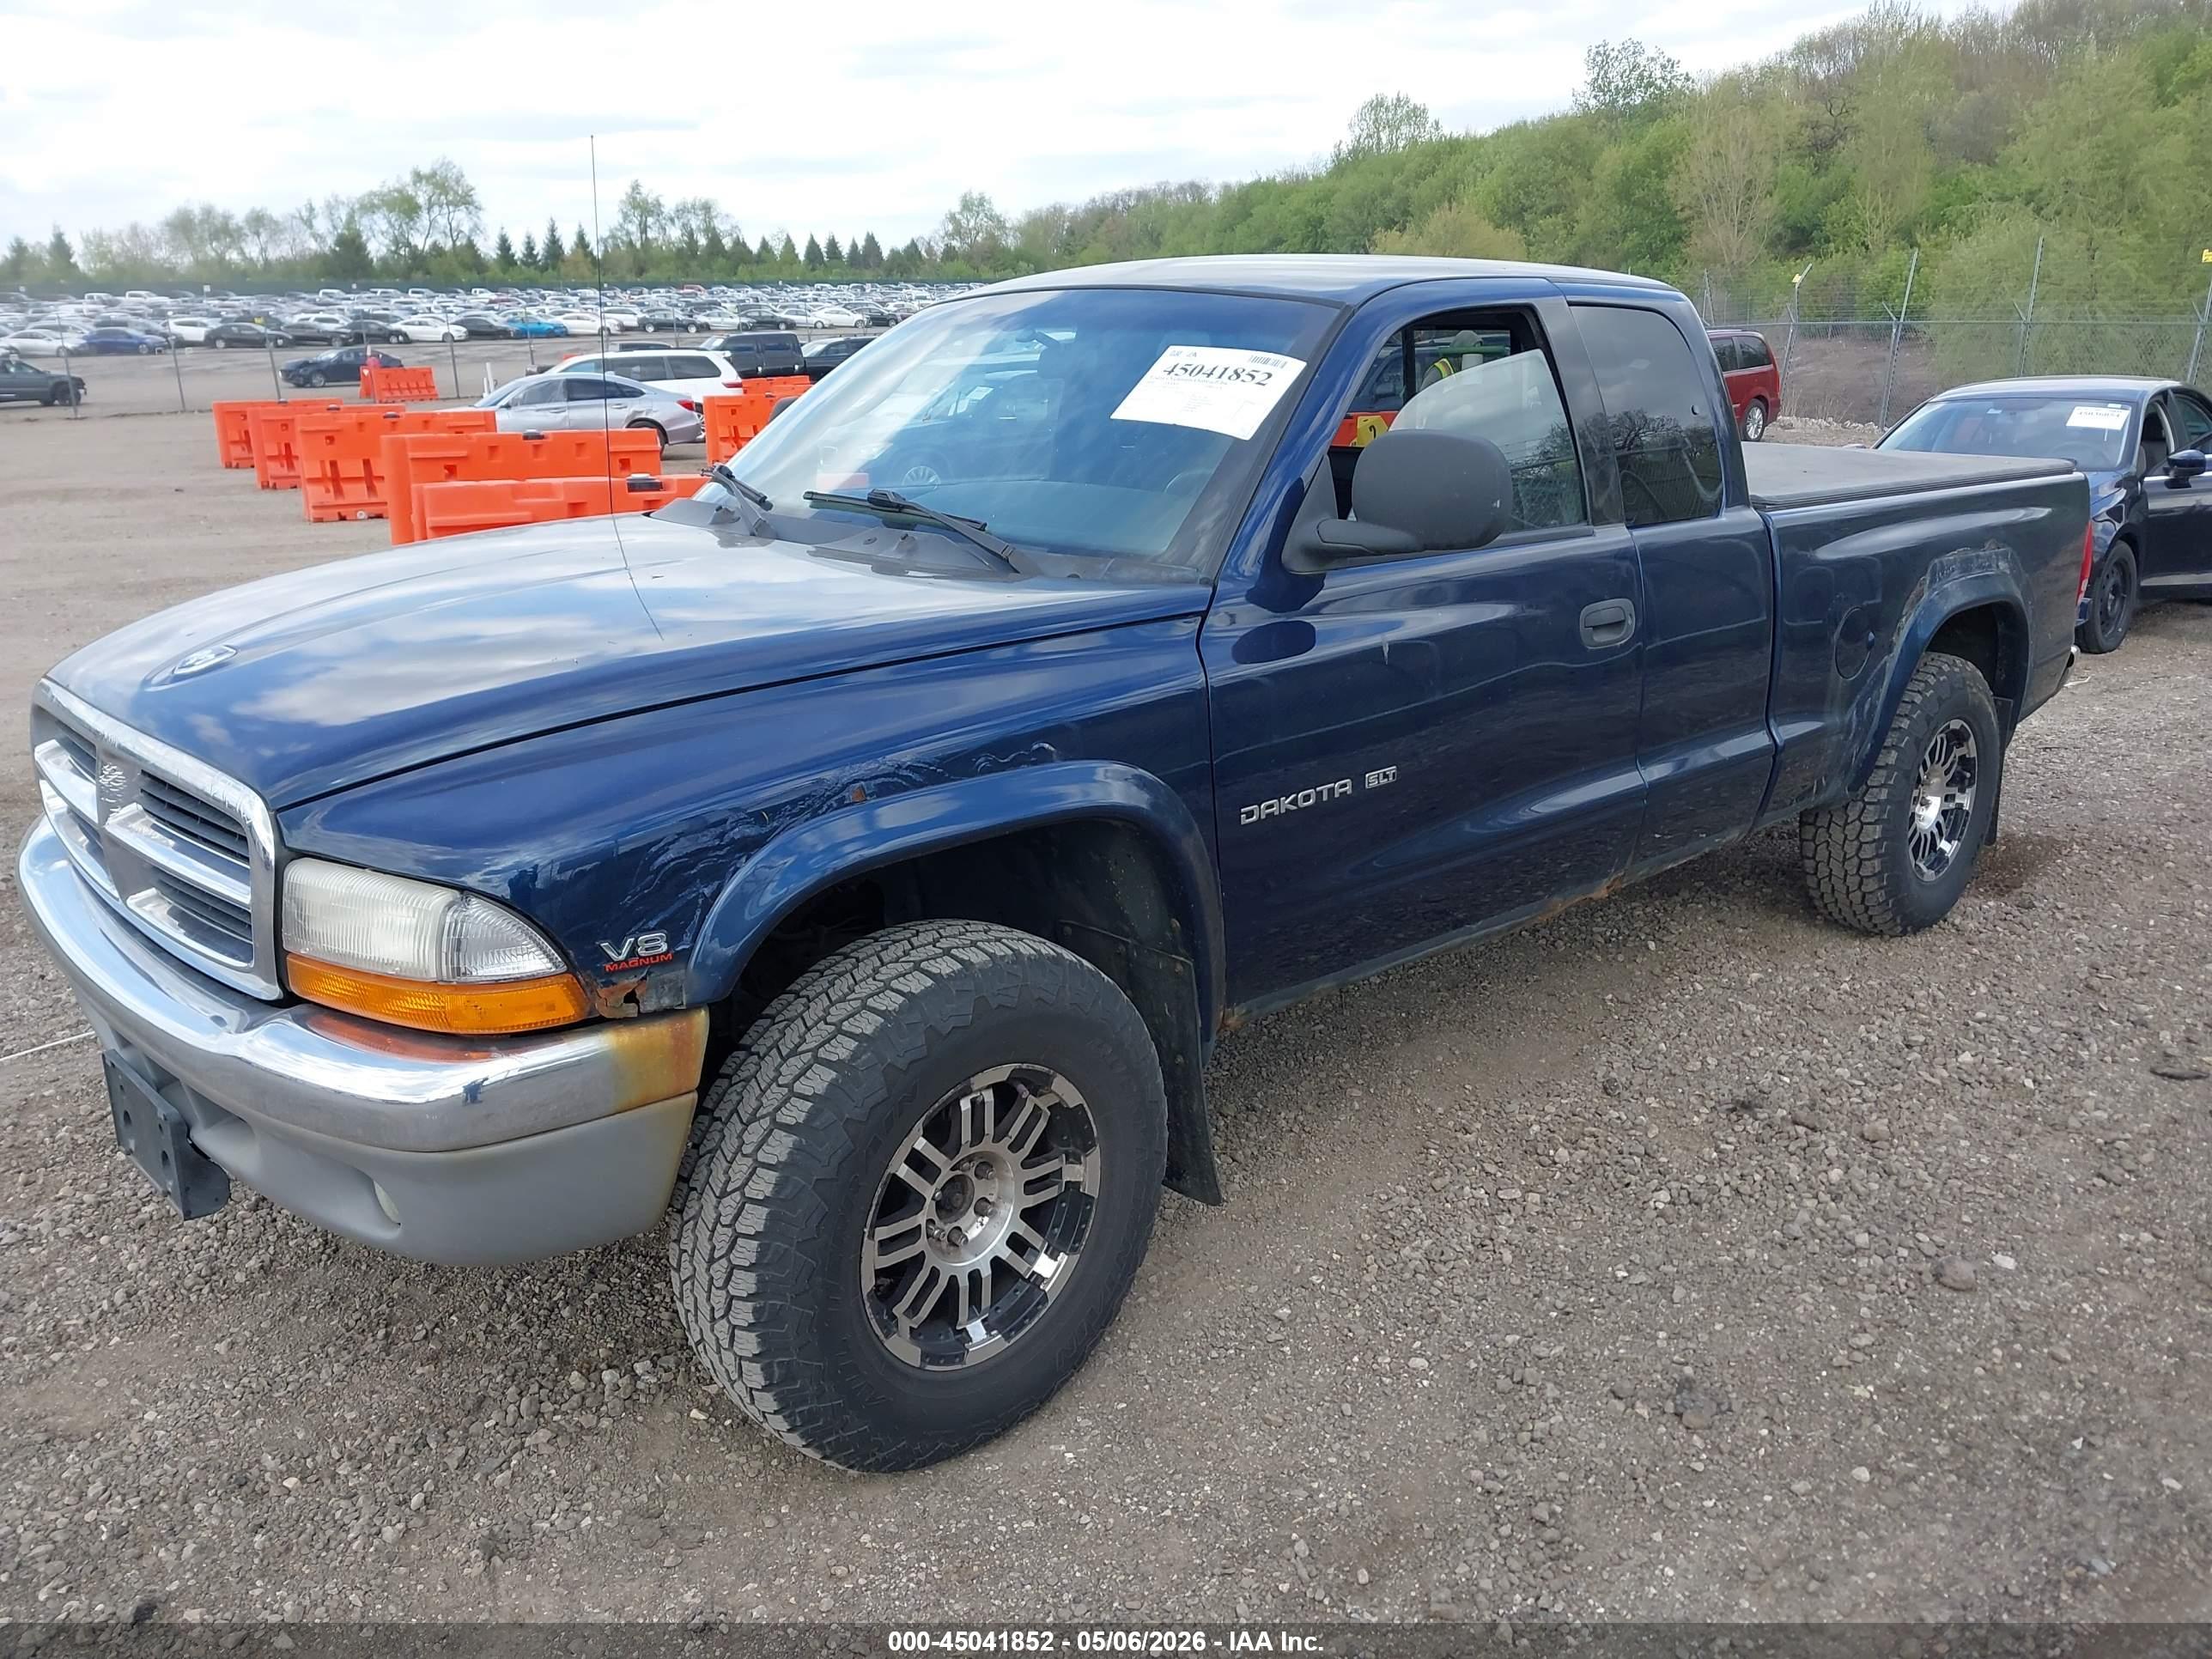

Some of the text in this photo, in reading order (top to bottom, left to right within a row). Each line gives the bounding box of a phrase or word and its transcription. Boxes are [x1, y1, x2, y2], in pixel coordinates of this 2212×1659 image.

[1163, 362, 1273, 386] 45041852
[1240, 768, 1397, 825] DAKOTA SLT
[599, 933, 668, 961] V8
[605, 953, 673, 972] MAGNUM
